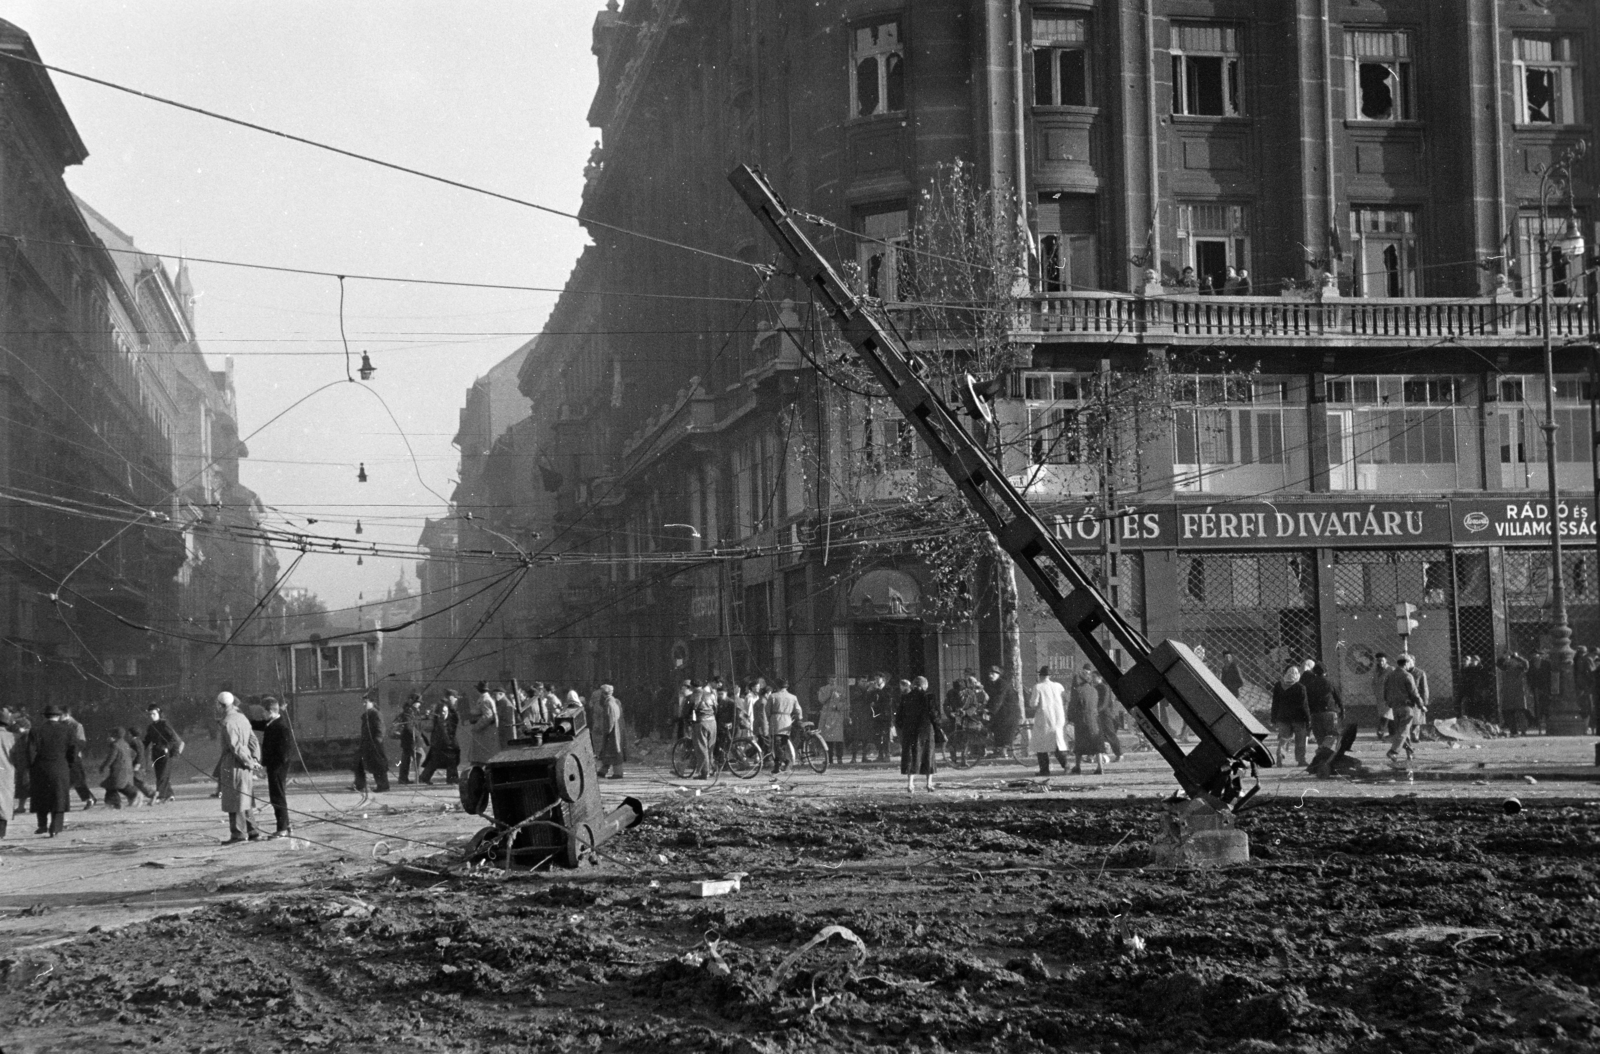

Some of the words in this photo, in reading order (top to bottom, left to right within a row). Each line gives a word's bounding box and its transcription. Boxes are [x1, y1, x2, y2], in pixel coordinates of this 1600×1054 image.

[1053, 506, 1110, 540] NŐ
[1122, 505, 1161, 540] ÉS
[1182, 506, 1268, 539] FÉRFI
[1275, 504, 1424, 538] DIVATÁRU
[1506, 500, 1569, 520] RÁDÓ
[1573, 504, 1588, 518] ÉS
